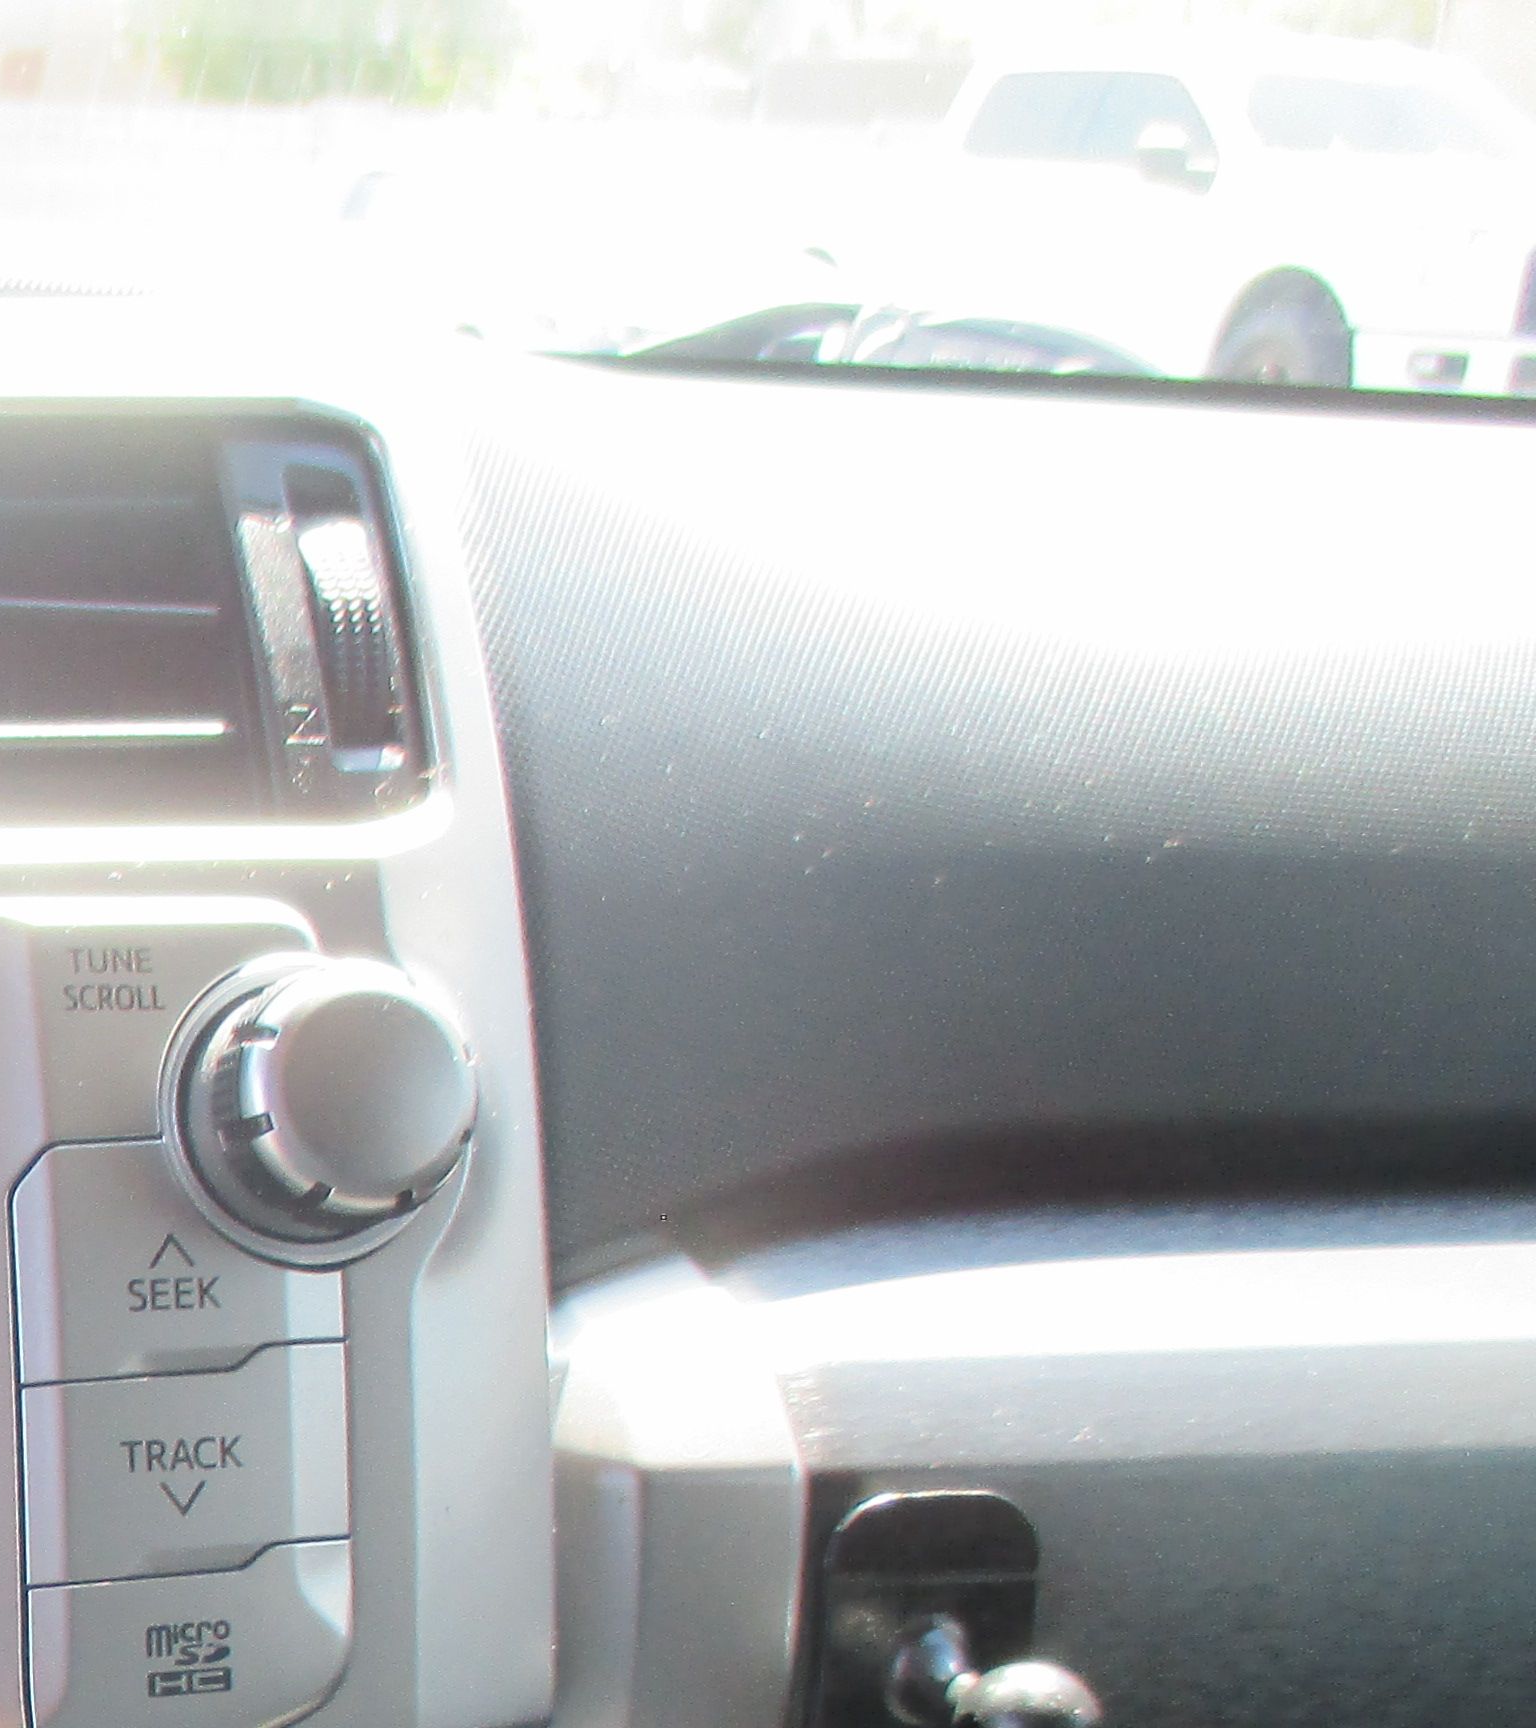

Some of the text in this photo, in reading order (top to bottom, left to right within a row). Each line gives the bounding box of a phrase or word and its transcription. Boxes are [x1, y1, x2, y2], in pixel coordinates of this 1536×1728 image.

[67, 948, 152, 973] TUNE
[63, 984, 166, 1011] SCROLL
[128, 1275, 224, 1312] SEEK
[121, 1434, 244, 1474] TRACK
[146, 1620, 230, 1657] micro
